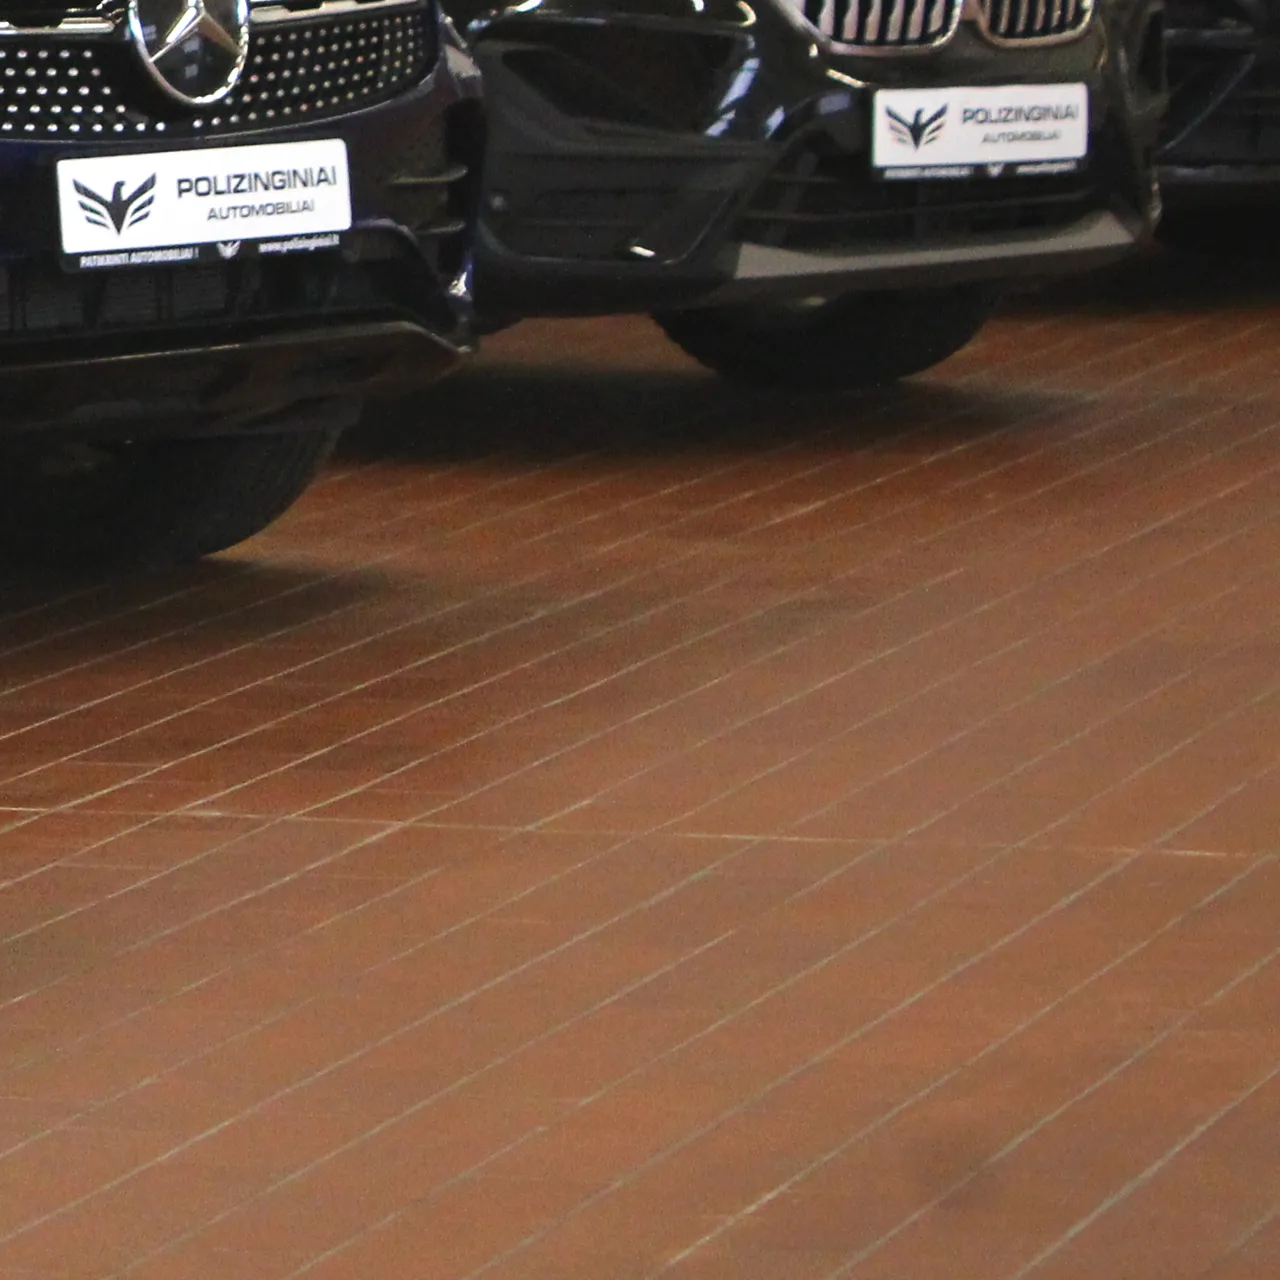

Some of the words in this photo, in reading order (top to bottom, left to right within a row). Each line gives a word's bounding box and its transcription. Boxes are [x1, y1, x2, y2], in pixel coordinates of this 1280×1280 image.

[962, 104, 1079, 124] POLIZINGINIAI
[177, 166, 337, 198] POLIZINGINIAI
[207, 199, 314, 221] AUTOMOBILIAI
